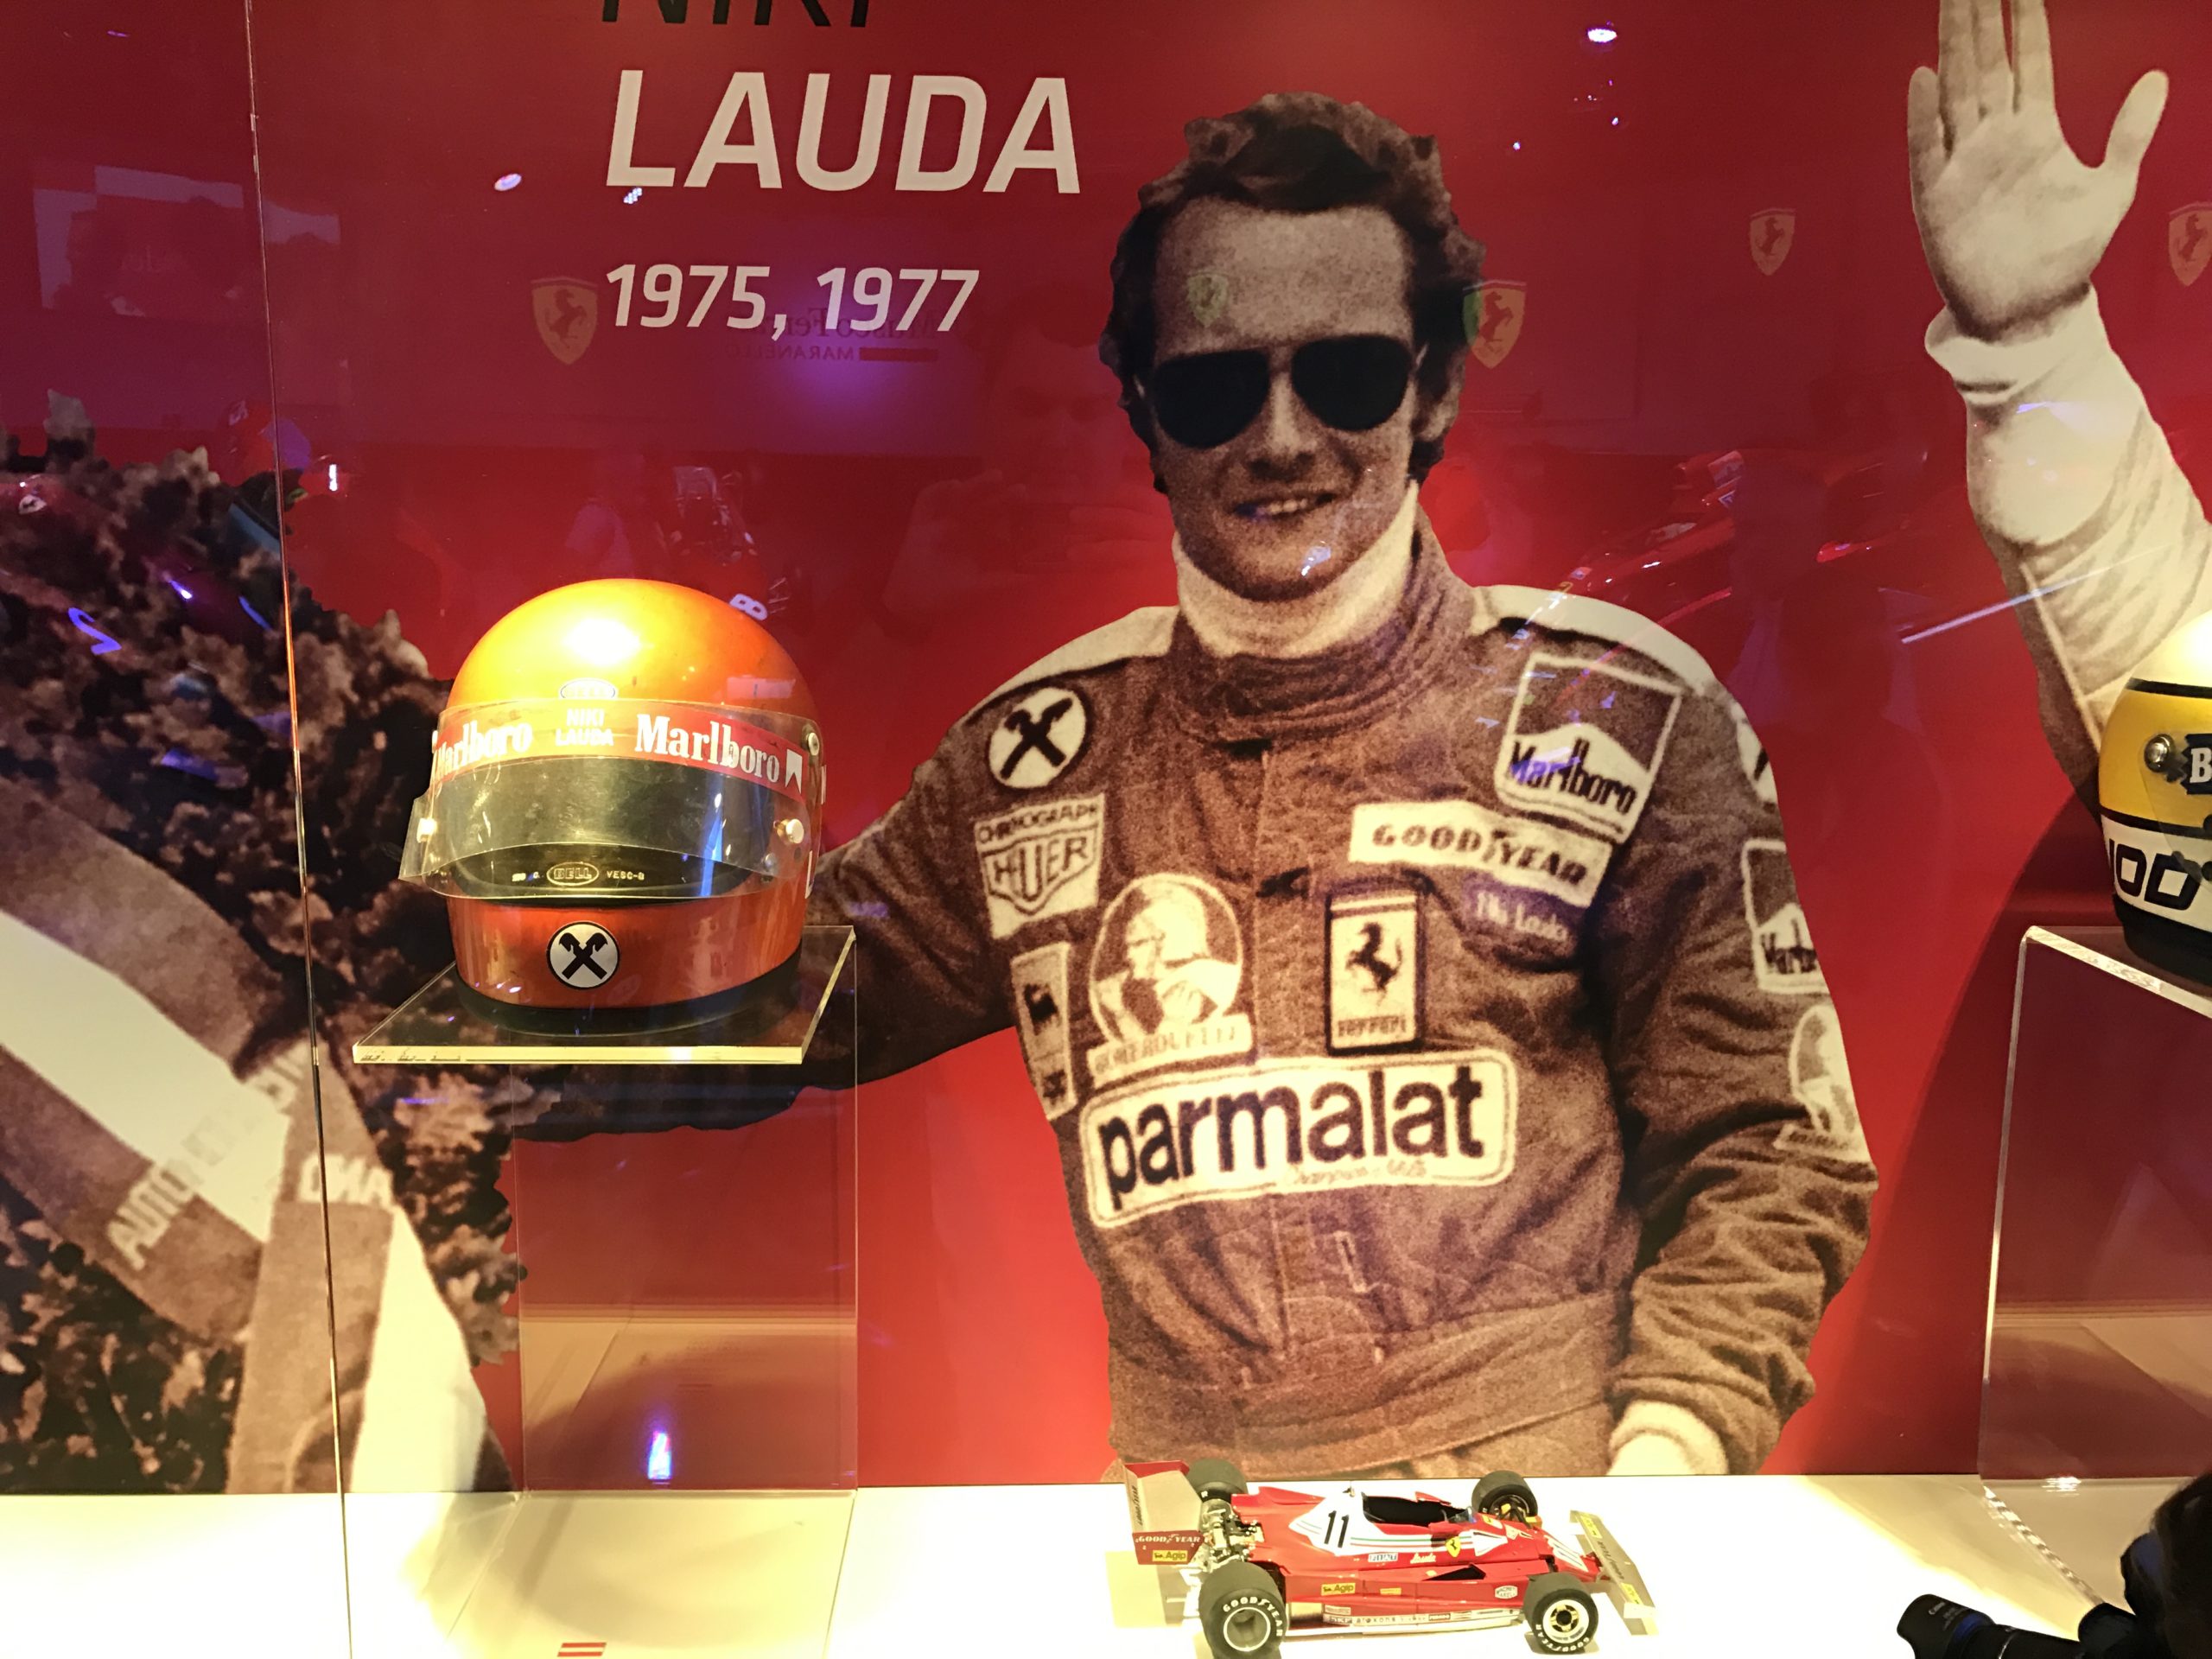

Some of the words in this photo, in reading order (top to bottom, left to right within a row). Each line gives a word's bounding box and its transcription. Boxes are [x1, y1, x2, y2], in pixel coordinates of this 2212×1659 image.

[606, 69, 1081, 194] LAUDA
[606, 263, 788, 340] 1975,
[817, 266, 980, 332] 1977
[634, 713, 779, 784] Marlboro
[1510, 737, 1638, 815] Marlboro
[1097, 1065, 1484, 1211] parmalat
[1166, 1551, 1186, 1560] Agip
[1324, 1510, 1350, 1548] 11
[1333, 1585, 1354, 1593] Agip
